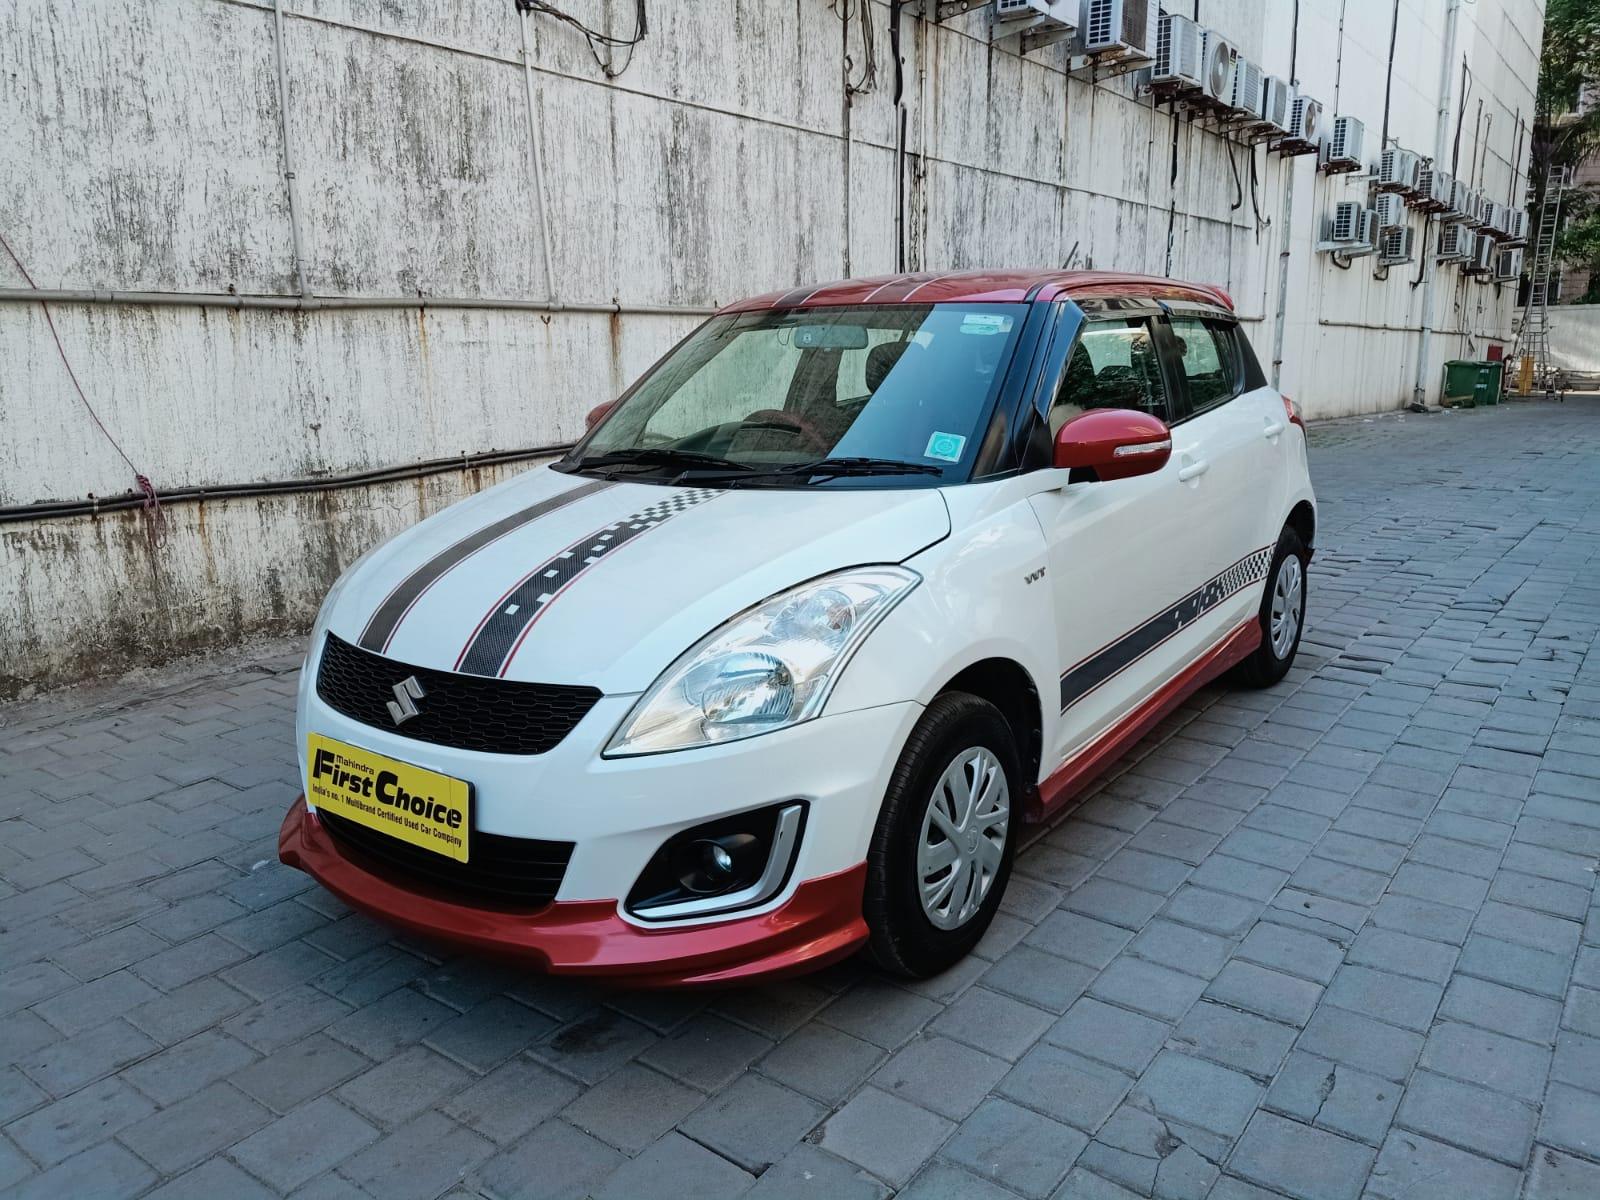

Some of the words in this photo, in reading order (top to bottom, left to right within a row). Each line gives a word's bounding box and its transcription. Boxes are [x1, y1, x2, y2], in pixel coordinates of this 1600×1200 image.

[312, 783, 331, 798] India's
[346, 796, 376, 816] Multibrand
[377, 807, 403, 825] Certified
[404, 817, 419, 831] Used
[420, 823, 432, 835] Car
[433, 827, 462, 848] Company
